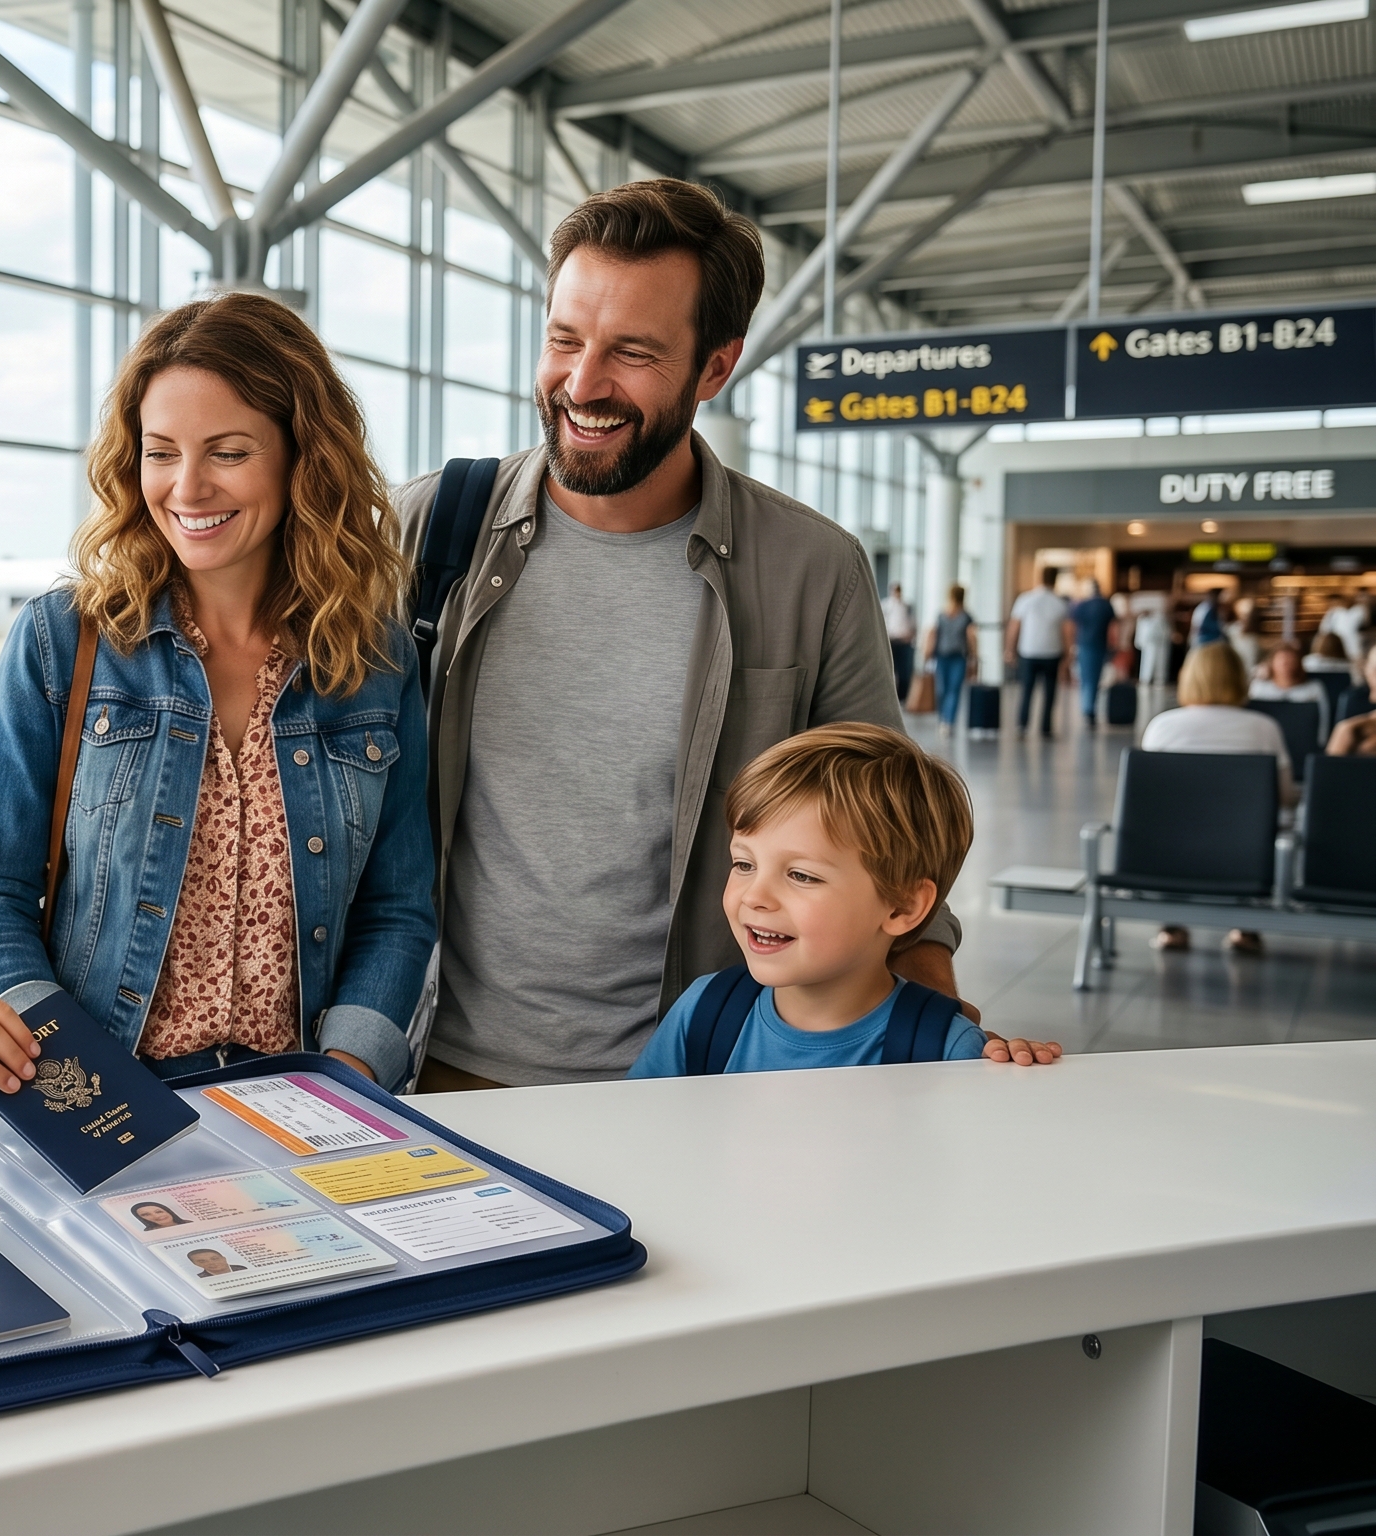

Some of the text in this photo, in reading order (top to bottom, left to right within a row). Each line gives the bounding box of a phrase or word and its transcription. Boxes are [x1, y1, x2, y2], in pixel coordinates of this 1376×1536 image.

[1125, 316, 1337, 359] Gates B1-B24
[841, 344, 992, 380] Departures
[840, 384, 1028, 421] Gates B1-B24
[1160, 469, 1335, 503] DUTY FREE
